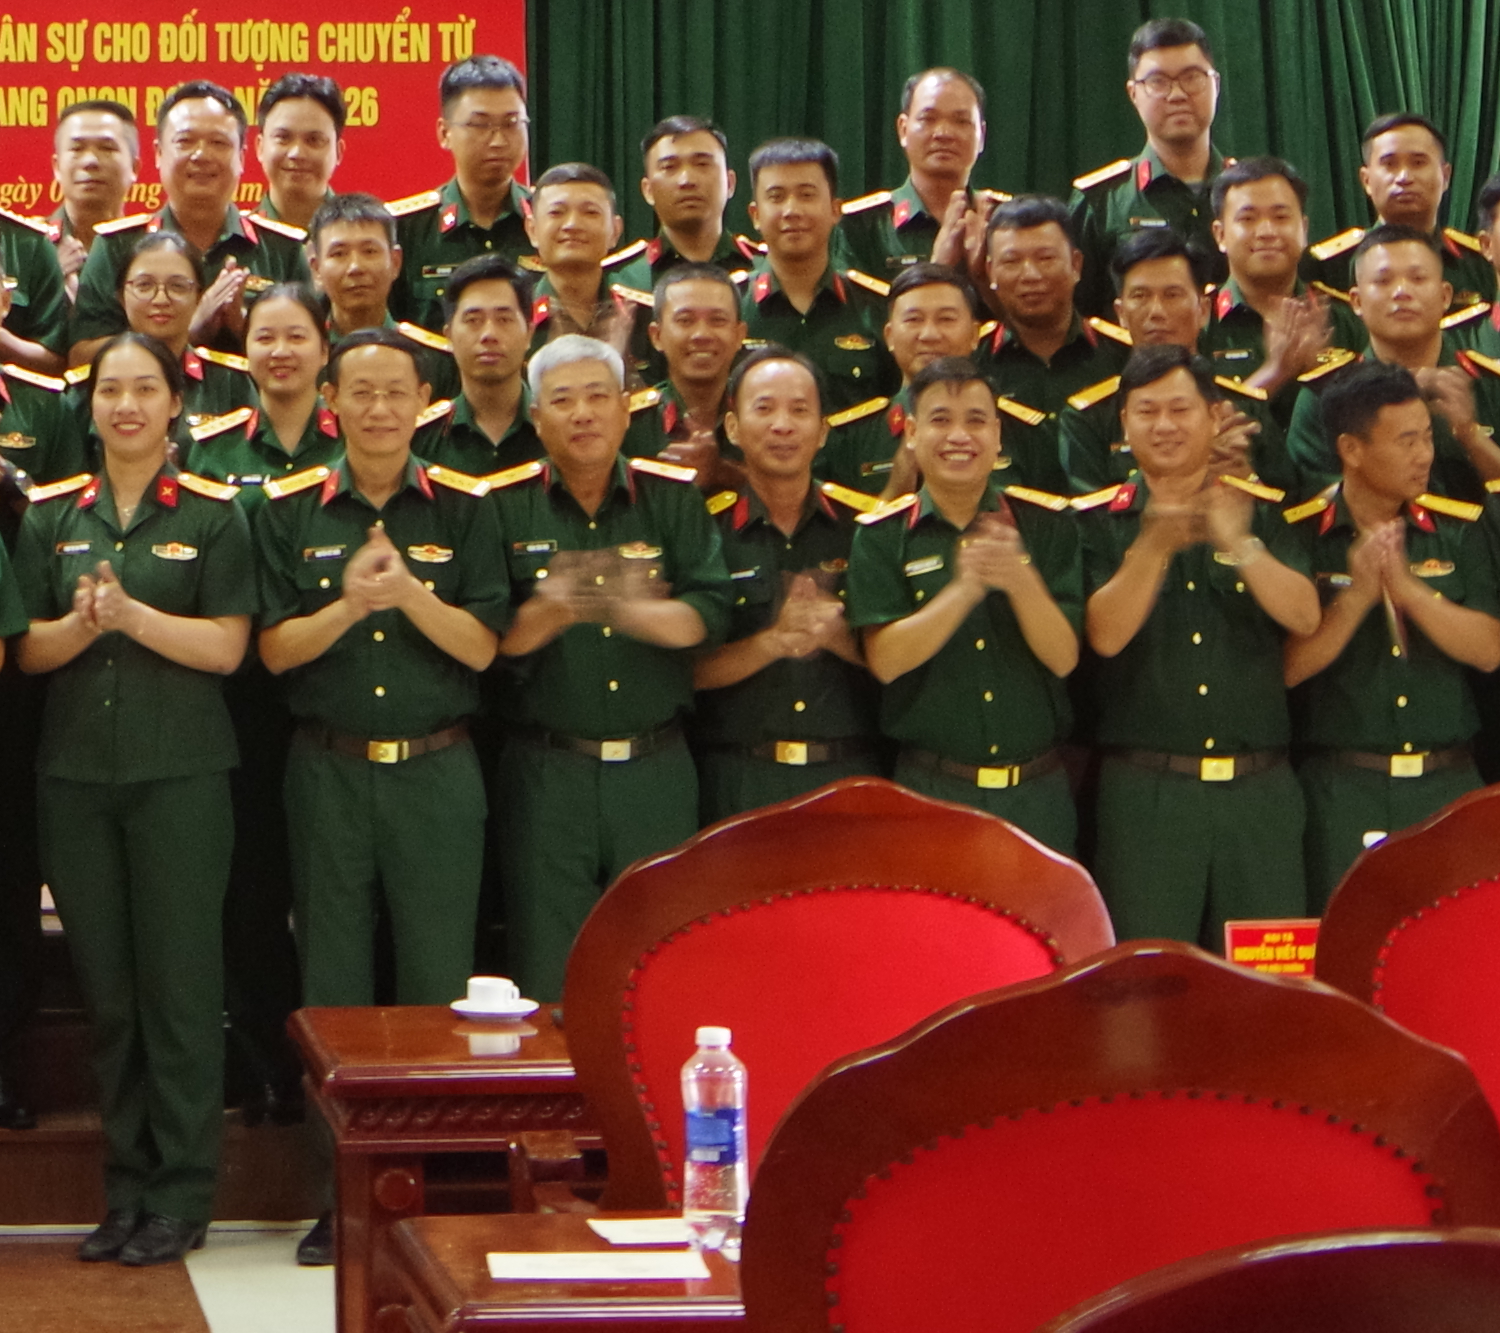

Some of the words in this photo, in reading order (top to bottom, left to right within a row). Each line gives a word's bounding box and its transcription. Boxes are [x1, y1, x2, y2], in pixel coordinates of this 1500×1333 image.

[46, 20, 88, 71] SỰ
[93, 23, 150, 62] CHO
[158, 9, 206, 62] ĐỐI
[215, 19, 309, 71] TƯỢNG
[318, 7, 430, 63] CHUYỂN
[437, 14, 476, 62] TỪ
